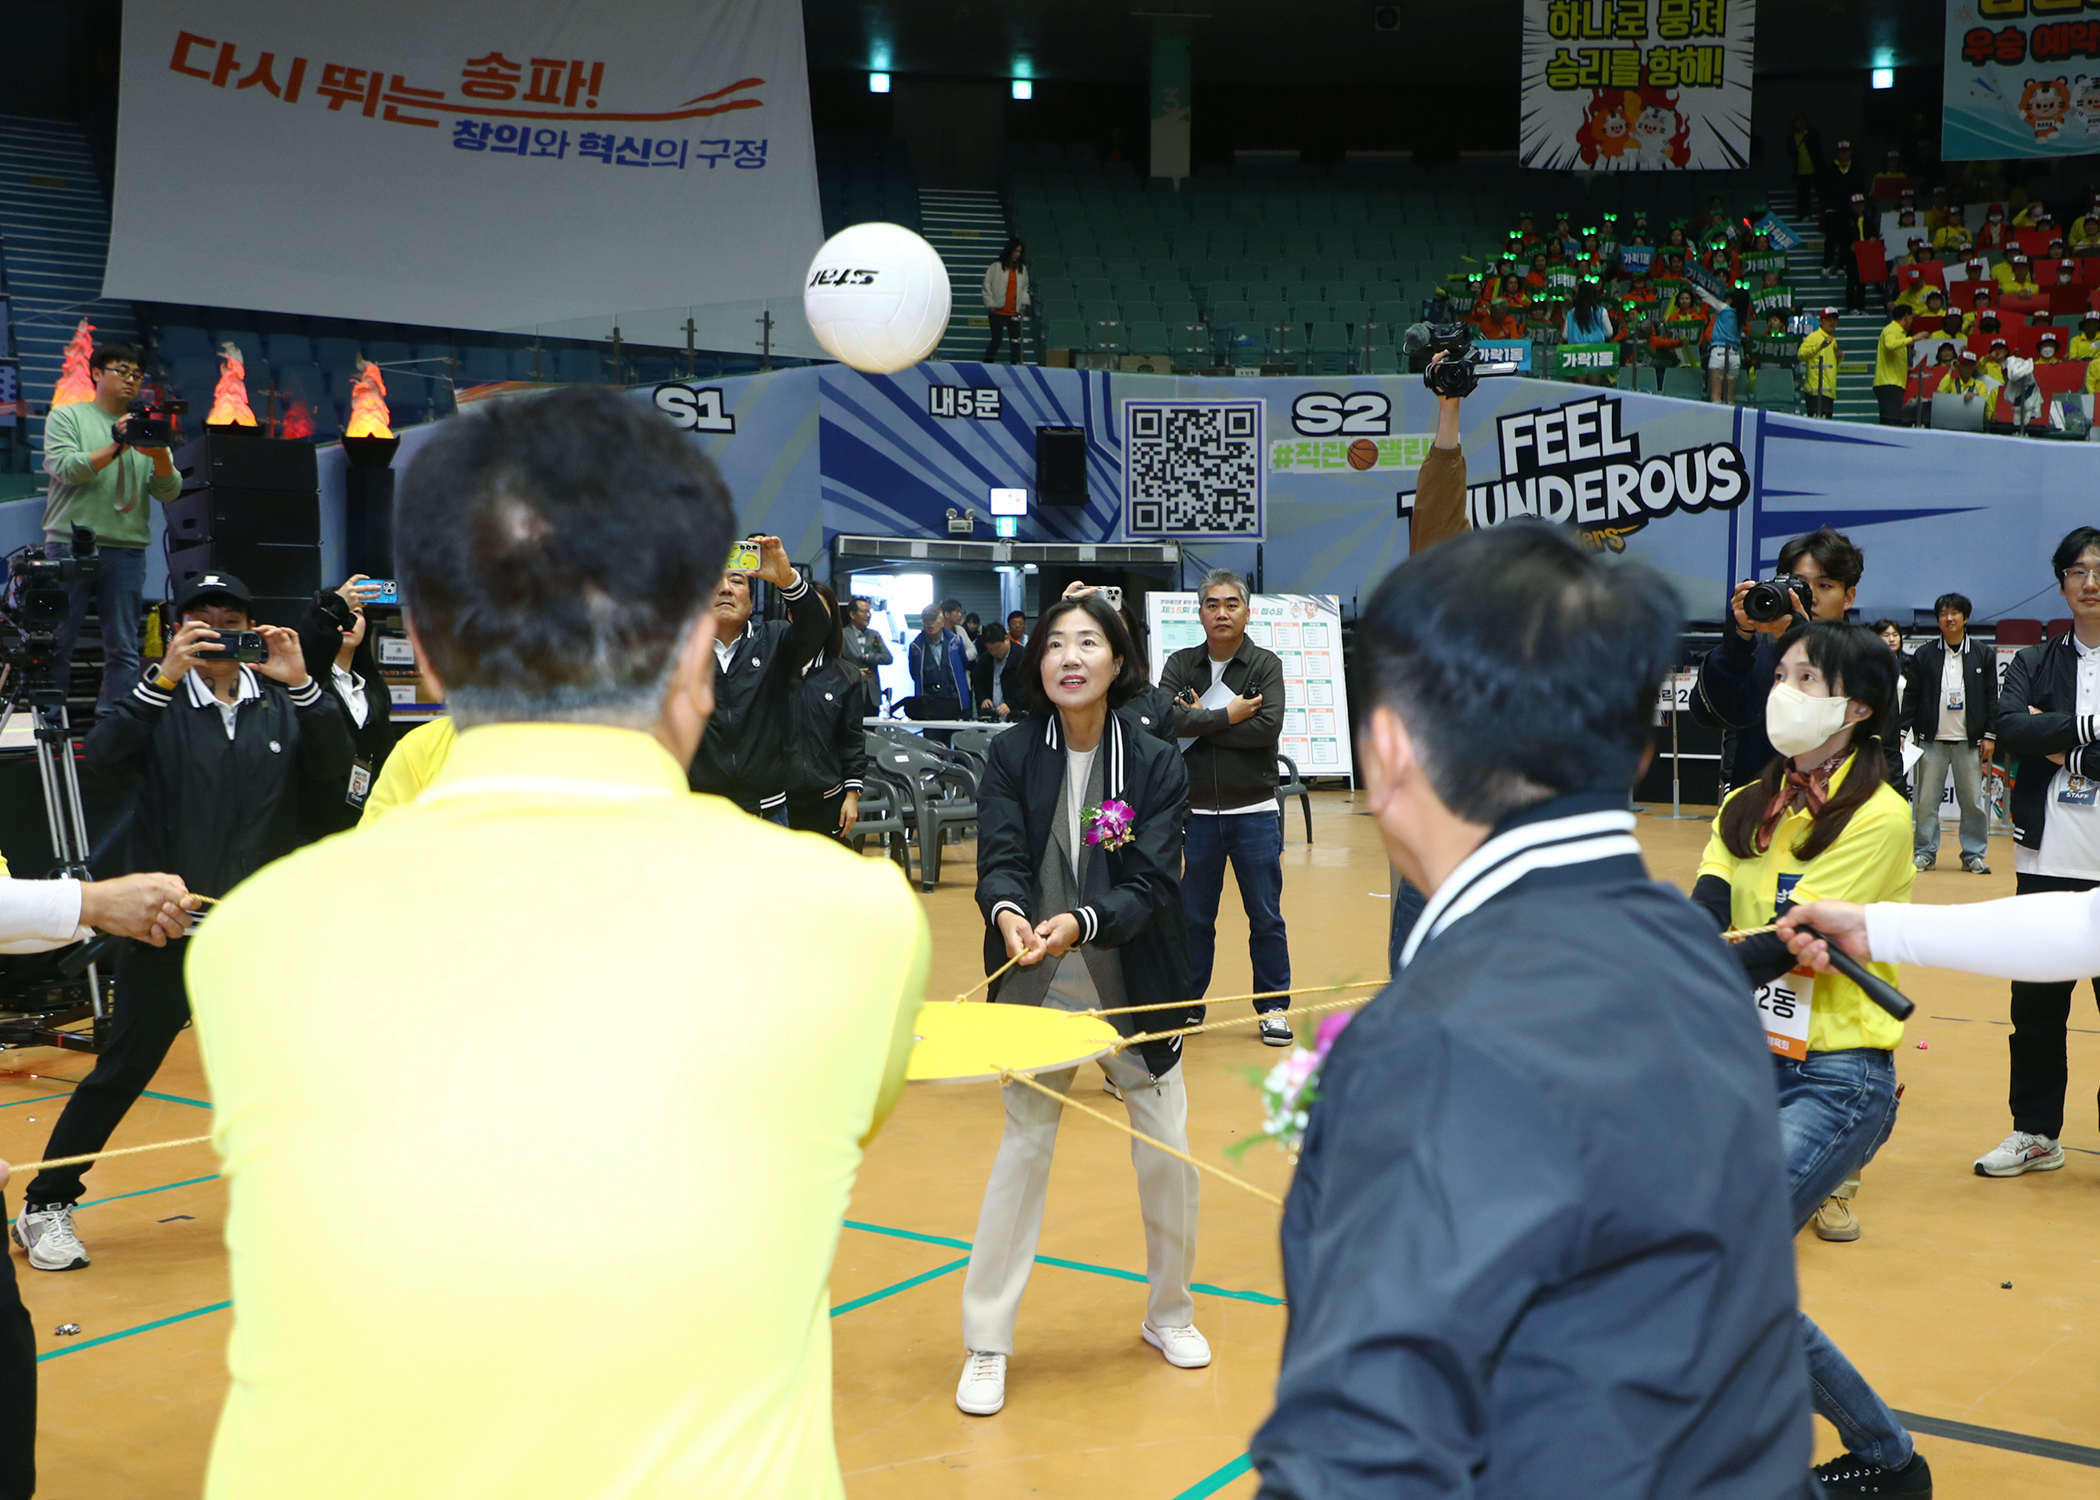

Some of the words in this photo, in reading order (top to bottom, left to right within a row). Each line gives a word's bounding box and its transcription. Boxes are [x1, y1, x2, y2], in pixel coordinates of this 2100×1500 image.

[1548, 0, 1648, 39] 하나로
[1657, 0, 1726, 38] 뭉쳐
[1962, 26, 2027, 66] 우승
[169, 30, 308, 104] 다시
[316, 62, 446, 128] 뛰는
[459, 50, 606, 111] 송파!
[1546, 48, 1641, 89] 승리를
[1647, 45, 1724, 88] 향해!
[451, 119, 571, 161] 창의와
[577, 131, 689, 171] 혁신의
[695, 138, 769, 171] 구정
[1478, 347, 1525, 363] 가락1동
[1562, 351, 1614, 368] 가락1동
[653, 384, 736, 434] S1
[928, 384, 1002, 420] 내5문
[1292, 391, 1391, 436] S2
[1377, 438, 1436, 467] 챌린
[1499, 397, 1634, 476] FEEL
[2066, 792, 2090, 800] STAFF
